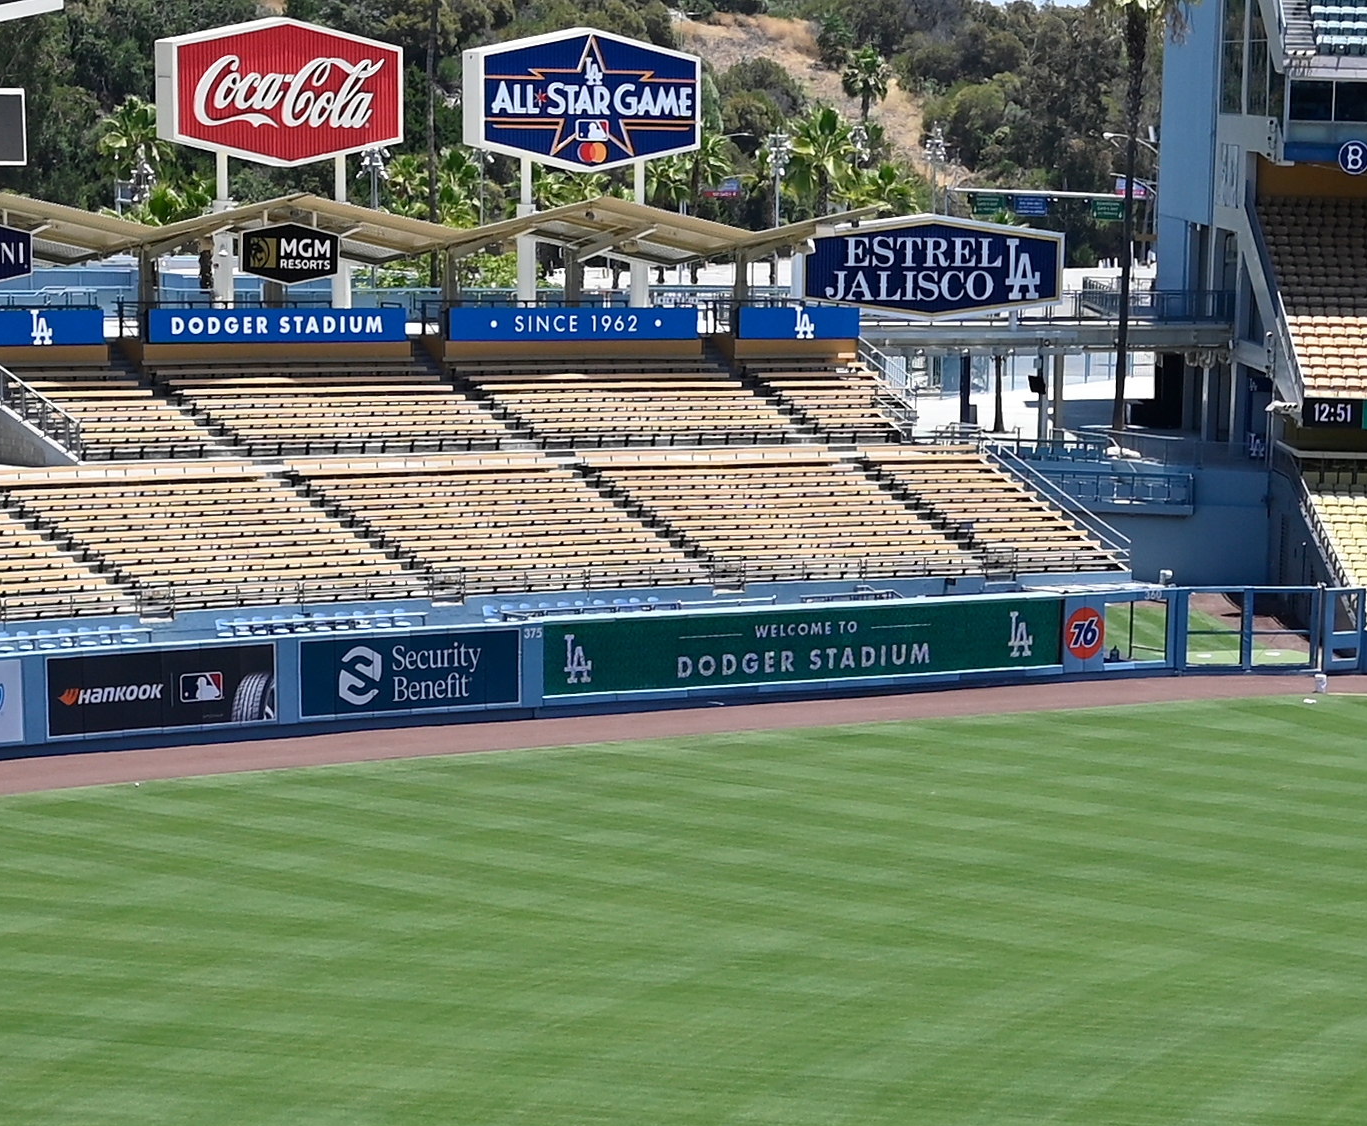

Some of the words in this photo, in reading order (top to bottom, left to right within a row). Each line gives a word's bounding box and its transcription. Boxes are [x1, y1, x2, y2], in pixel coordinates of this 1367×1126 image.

[194, 54, 385, 129] Coca-Cola
[614, 83, 692, 116] GAME
[280, 238, 331, 258] MGM
[280, 259, 331, 271] RESORTS
[825, 271, 994, 301] JALISCO
[171, 316, 268, 335] DODGER
[279, 315, 383, 334] STADIUM
[514, 315, 578, 333] SINCE
[591, 315, 638, 332] 1962
[1314, 403, 1351, 422] 12:51
[523, 627, 543, 639] 375
[755, 621, 832, 638] WELCOME
[838, 620, 858, 633] TO
[1070, 616, 1099, 648] 76
[392, 642, 481, 672] Security
[677, 650, 794, 678] DODGER
[809, 643, 930, 670] STADIUM
[393, 672, 470, 702] Benefit
